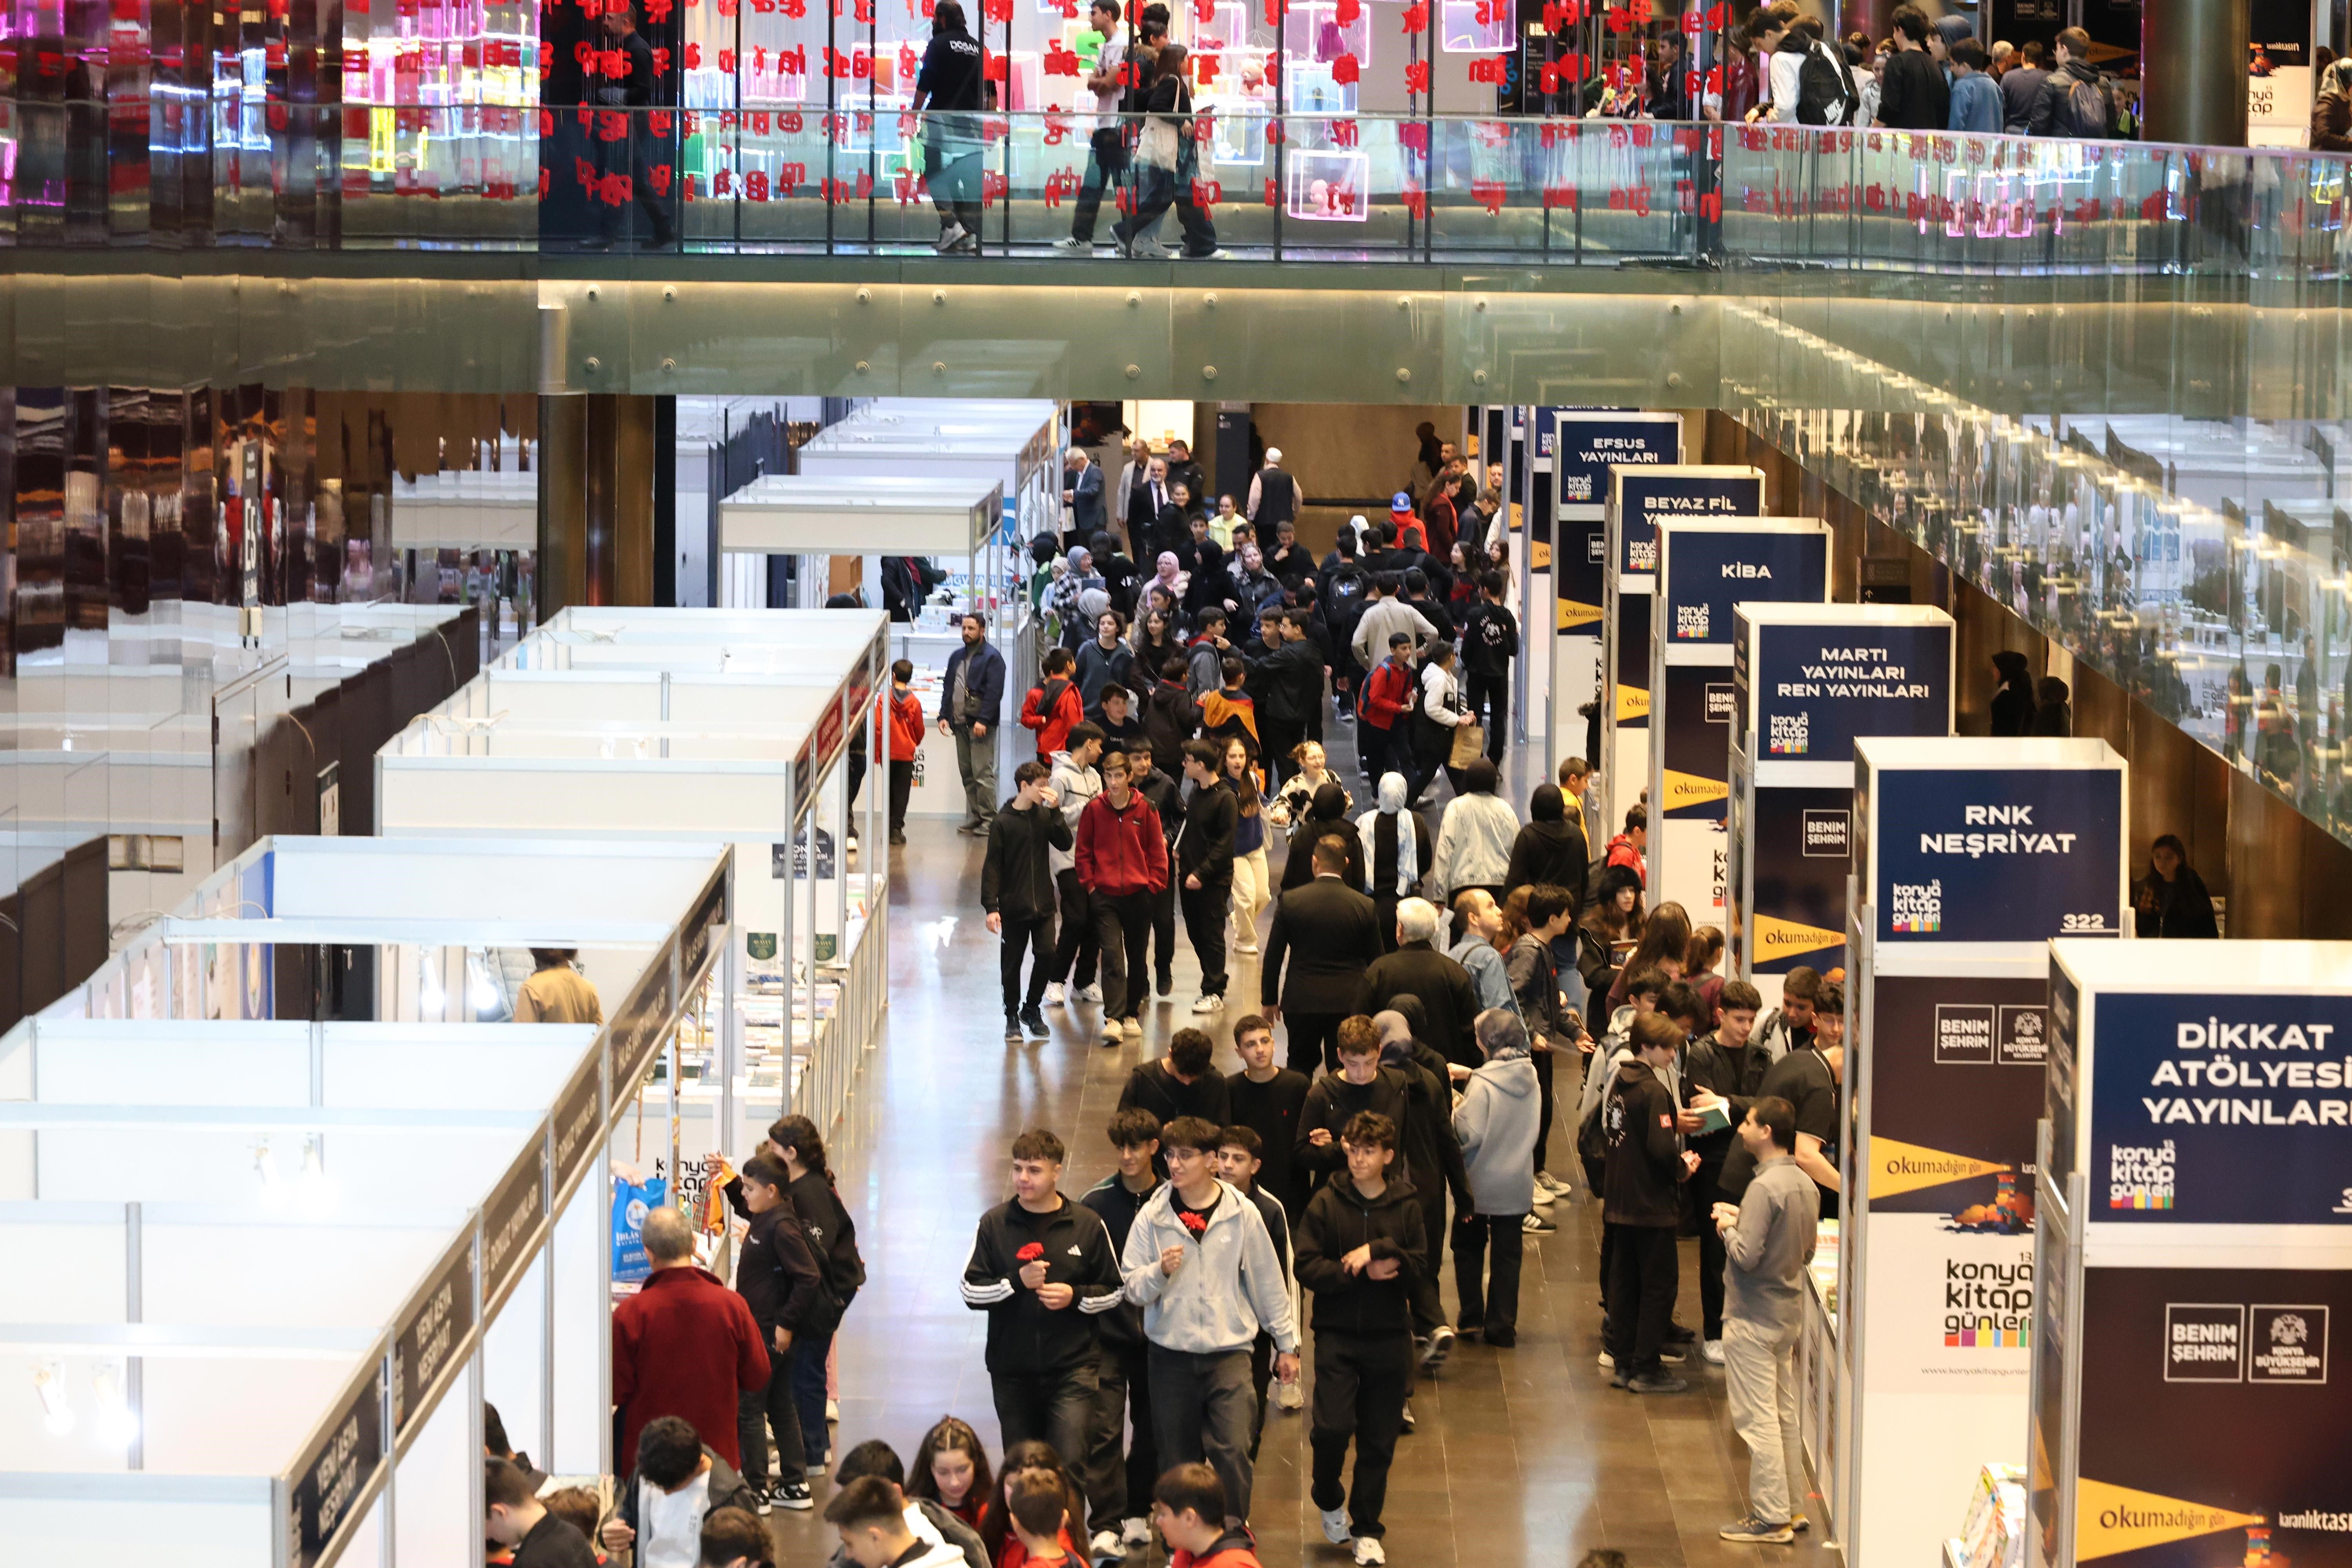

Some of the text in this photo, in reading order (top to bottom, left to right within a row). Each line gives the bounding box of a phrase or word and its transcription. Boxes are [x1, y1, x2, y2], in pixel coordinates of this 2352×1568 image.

[1824, 98, 1841, 123] NIKE
[1593, 438, 1645, 449] EFSUS
[1579, 452, 1658, 463] YAYINLARI
[1644, 495, 1736, 510] BEYAZ FİL
[1722, 562, 1772, 579] KİBA
[1678, 605, 1709, 616] konya
[1678, 615, 1709, 625] kitap
[1821, 648, 1887, 661] MARTI
[1802, 666, 1905, 680] YAYINLARI
[1778, 684, 1929, 698] REN YAYINLARI
[1770, 714, 1808, 728] konya
[1770, 725, 1808, 739] kitap
[1966, 805, 2033, 826] RNK
[1808, 821, 1846, 833] BENİM
[1808, 834, 1846, 846] ŞEHRİM
[1921, 829, 2076, 858] NEŞRİYAT
[1893, 883, 1941, 898] konya
[1893, 897, 1941, 913] kitap
[2063, 914, 2104, 929] 322
[1766, 929, 1829, 945] okumadığın
[1941, 1019, 1989, 1034] BENİM
[2178, 1016, 2334, 1050] DİKKAT
[1940, 1034, 1989, 1049] ŞEHRİM
[2151, 1054, 2352, 1088] ATÖLYESİ
[2143, 1098, 2352, 1126] YAYINLAR
[2112, 1145, 2175, 1164] konya
[1887, 1156, 1967, 1175] okumadığın
[2112, 1163, 2175, 1184] kitap
[2111, 1184, 2174, 1200] günleri
[1947, 1259, 2033, 1286] konya
[1946, 1283, 2032, 1316] kitap
[1945, 1312, 2032, 1335] günleri
[2173, 1324, 2237, 1343] BENİM
[2172, 1345, 2236, 1364] ŞEHRİM
[2100, 1504, 2205, 1530] okumadığın
[2209, 1512, 2225, 1528] gün
